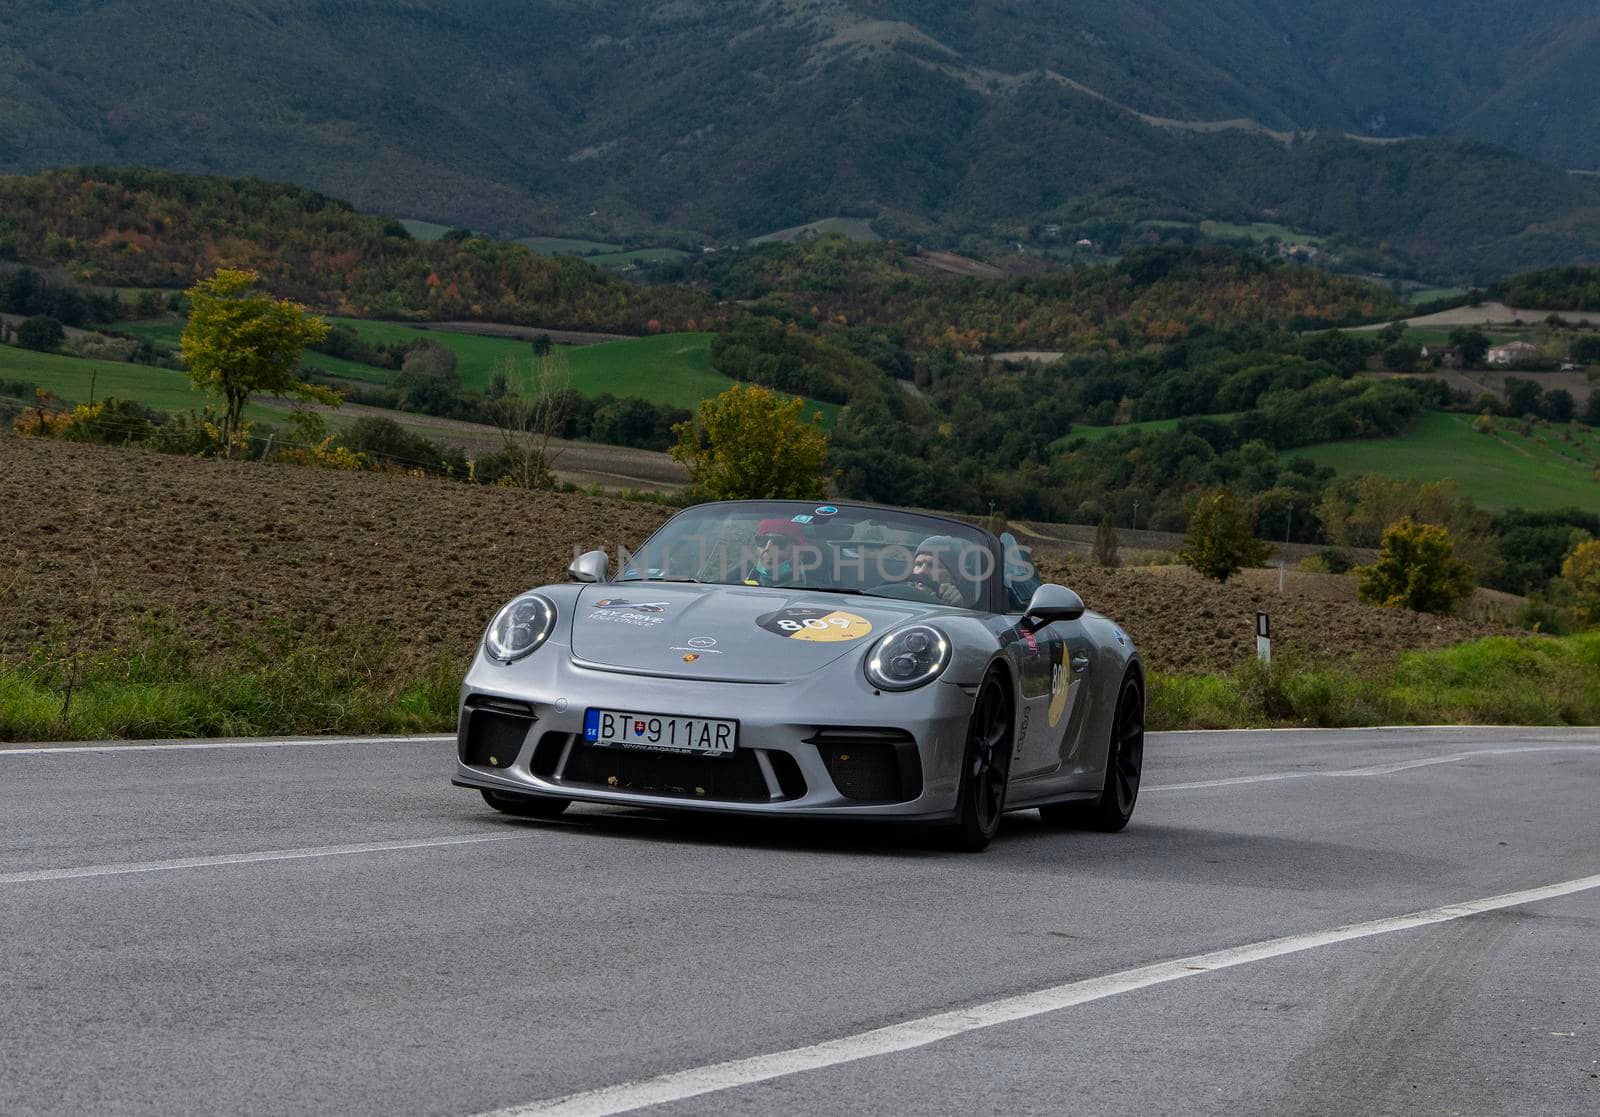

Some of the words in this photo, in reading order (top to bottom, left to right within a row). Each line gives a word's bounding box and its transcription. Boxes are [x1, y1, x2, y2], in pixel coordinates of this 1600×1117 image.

[777, 617, 851, 631] 809
[586, 728, 597, 736] SK
[601, 713, 633, 740] BT
[647, 718, 731, 749] 911AR
